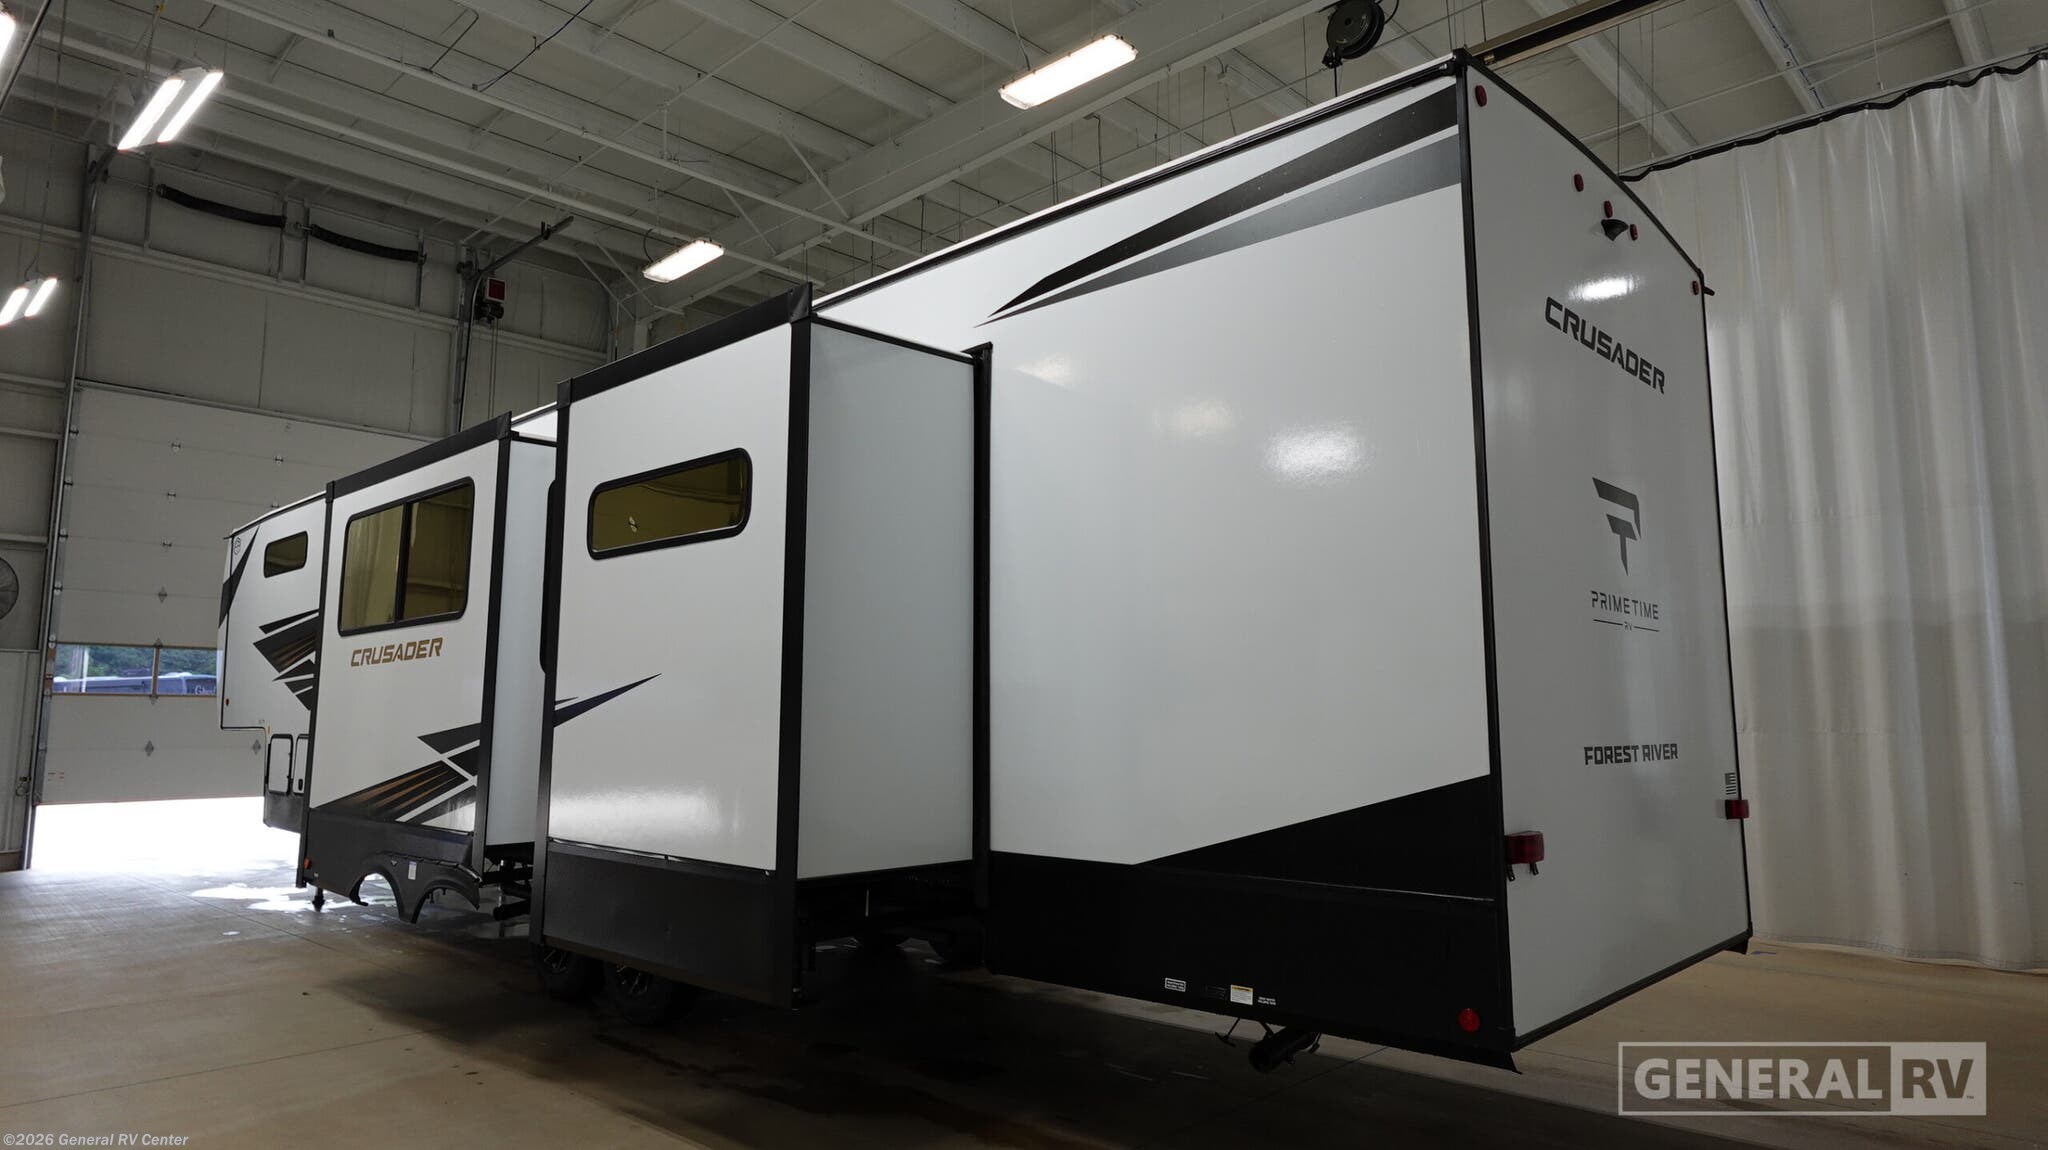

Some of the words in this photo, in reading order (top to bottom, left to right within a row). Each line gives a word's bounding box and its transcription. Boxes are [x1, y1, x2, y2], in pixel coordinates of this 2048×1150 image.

[1545, 296, 1665, 395] CRUSADER
[350, 637, 444, 667] CRUSADER
[1584, 745, 1640, 765] FOREST
[1642, 743, 1679, 762] RIVER
